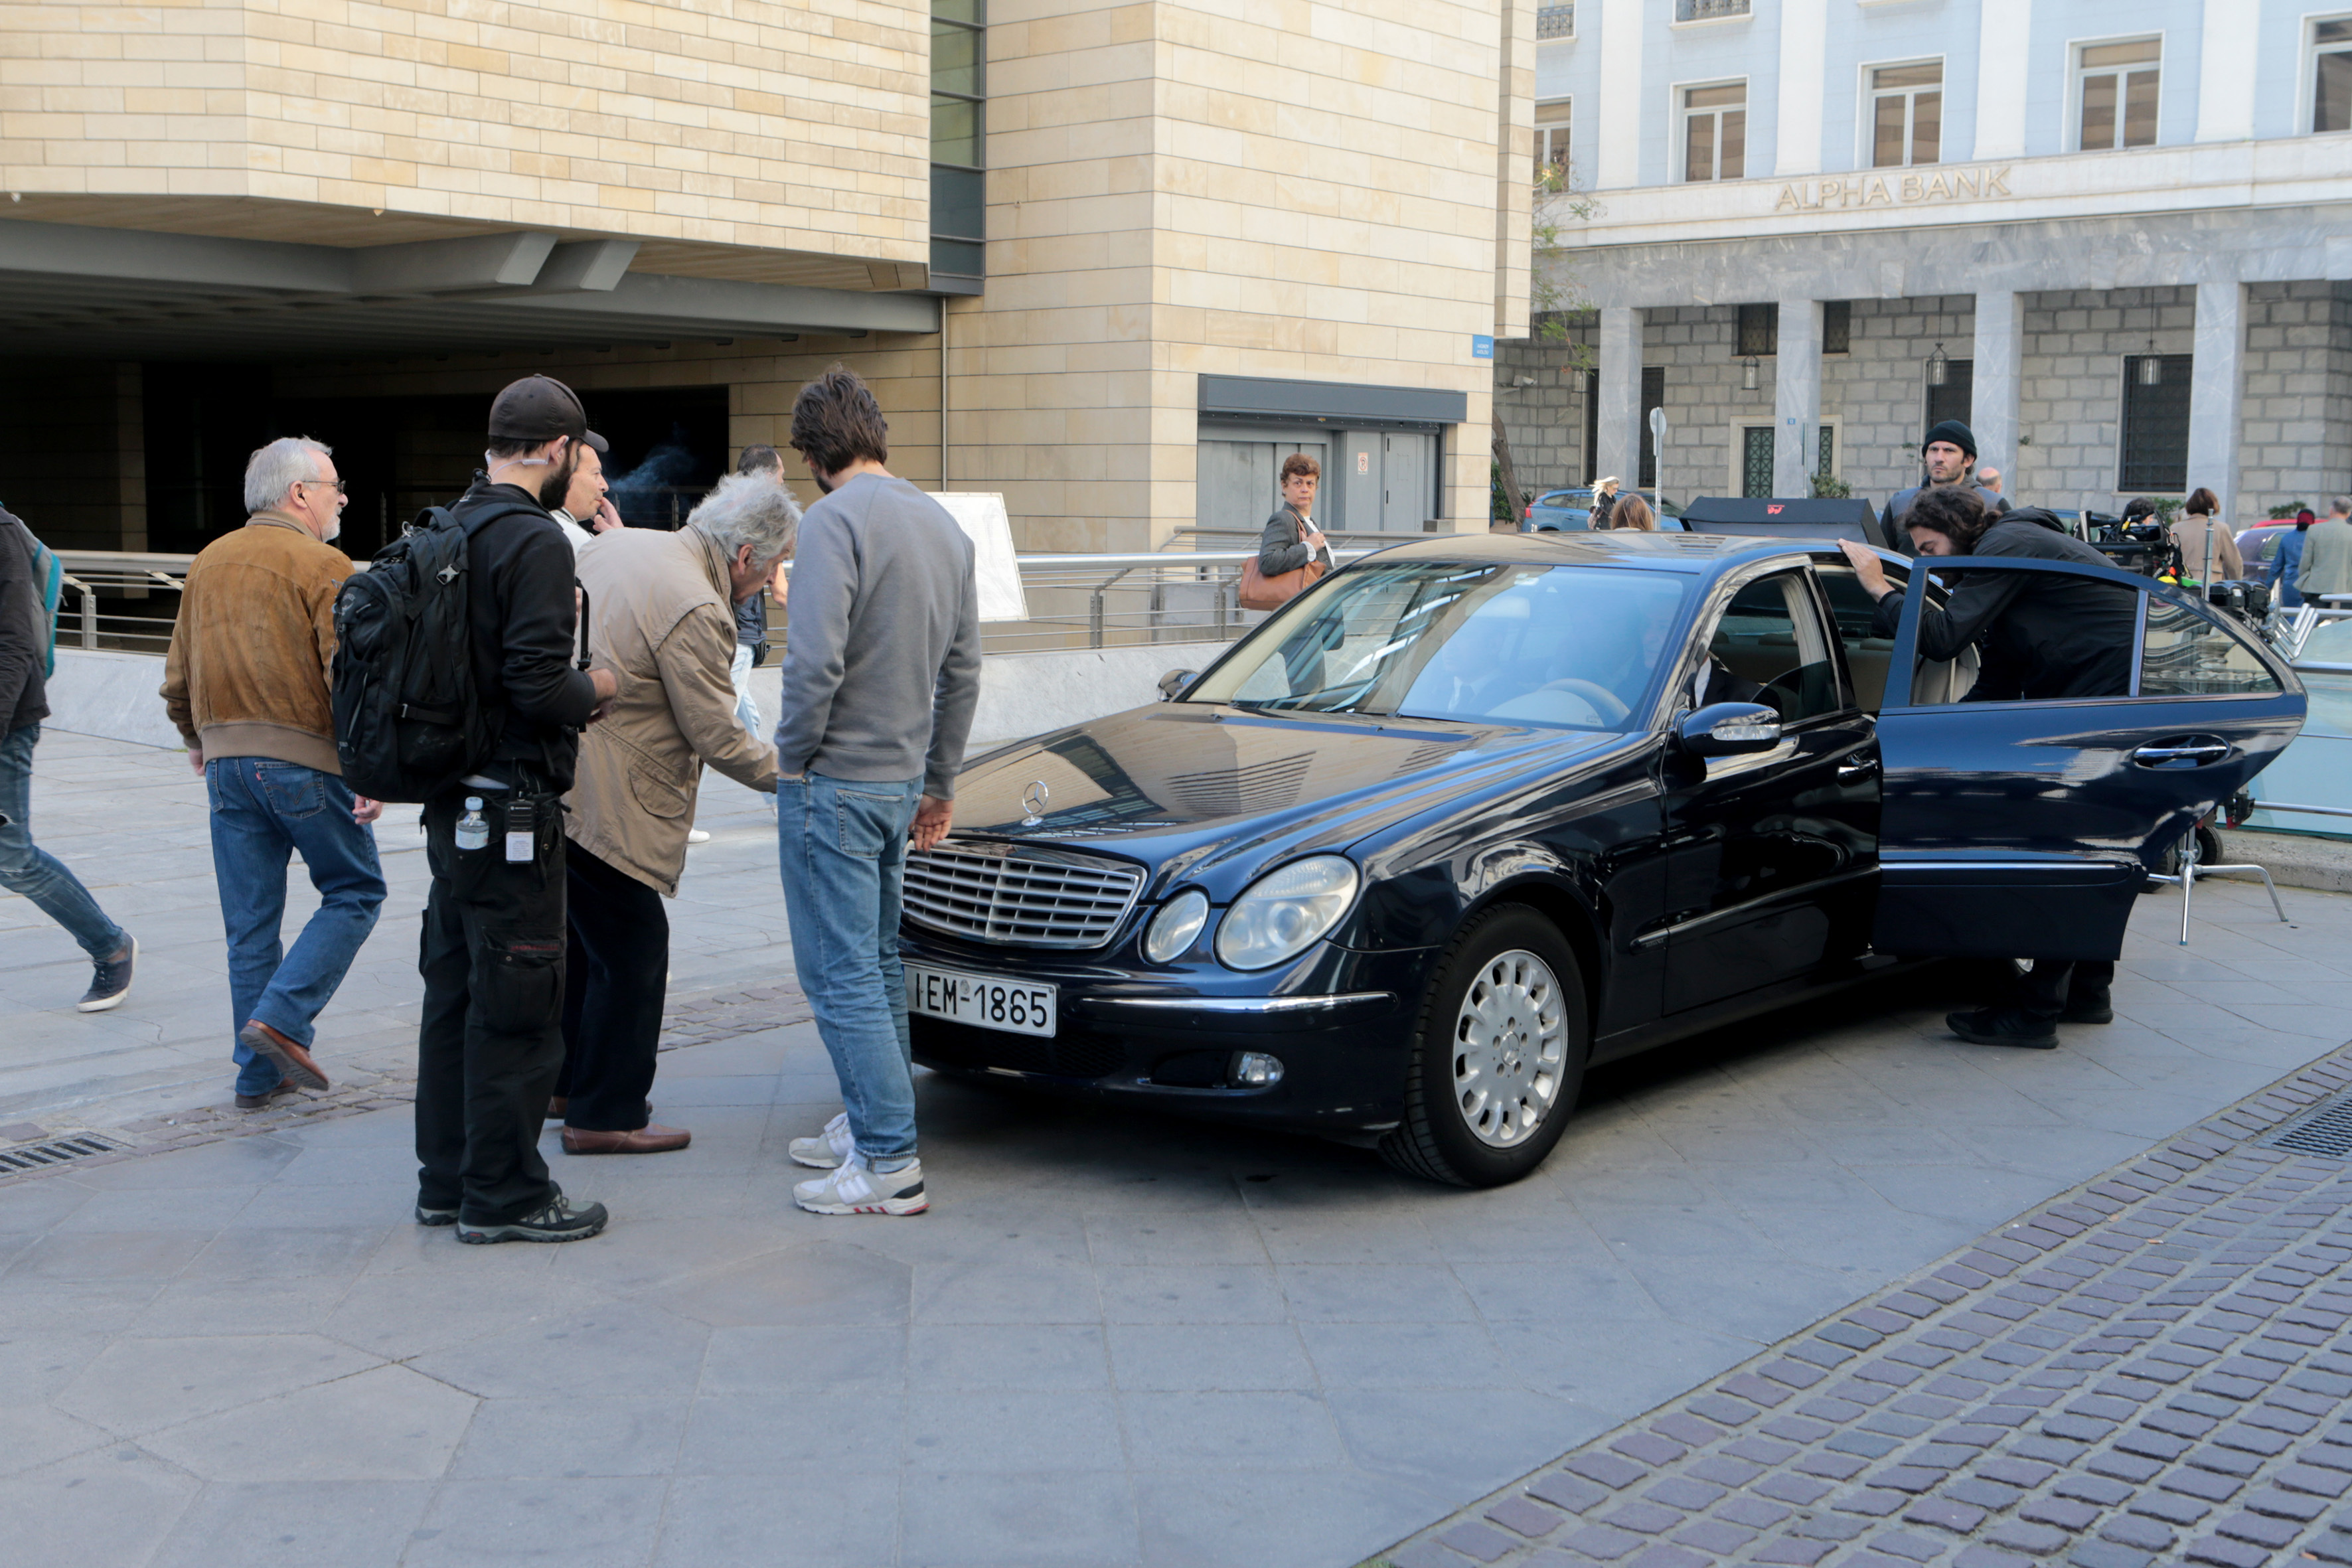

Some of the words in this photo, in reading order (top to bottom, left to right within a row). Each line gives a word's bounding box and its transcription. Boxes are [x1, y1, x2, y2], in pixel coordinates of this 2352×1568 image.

[1776, 177, 1891, 210] ALPHA
[1900, 167, 2011, 202] BANK
[916, 973, 1048, 1028] IEM-1865
